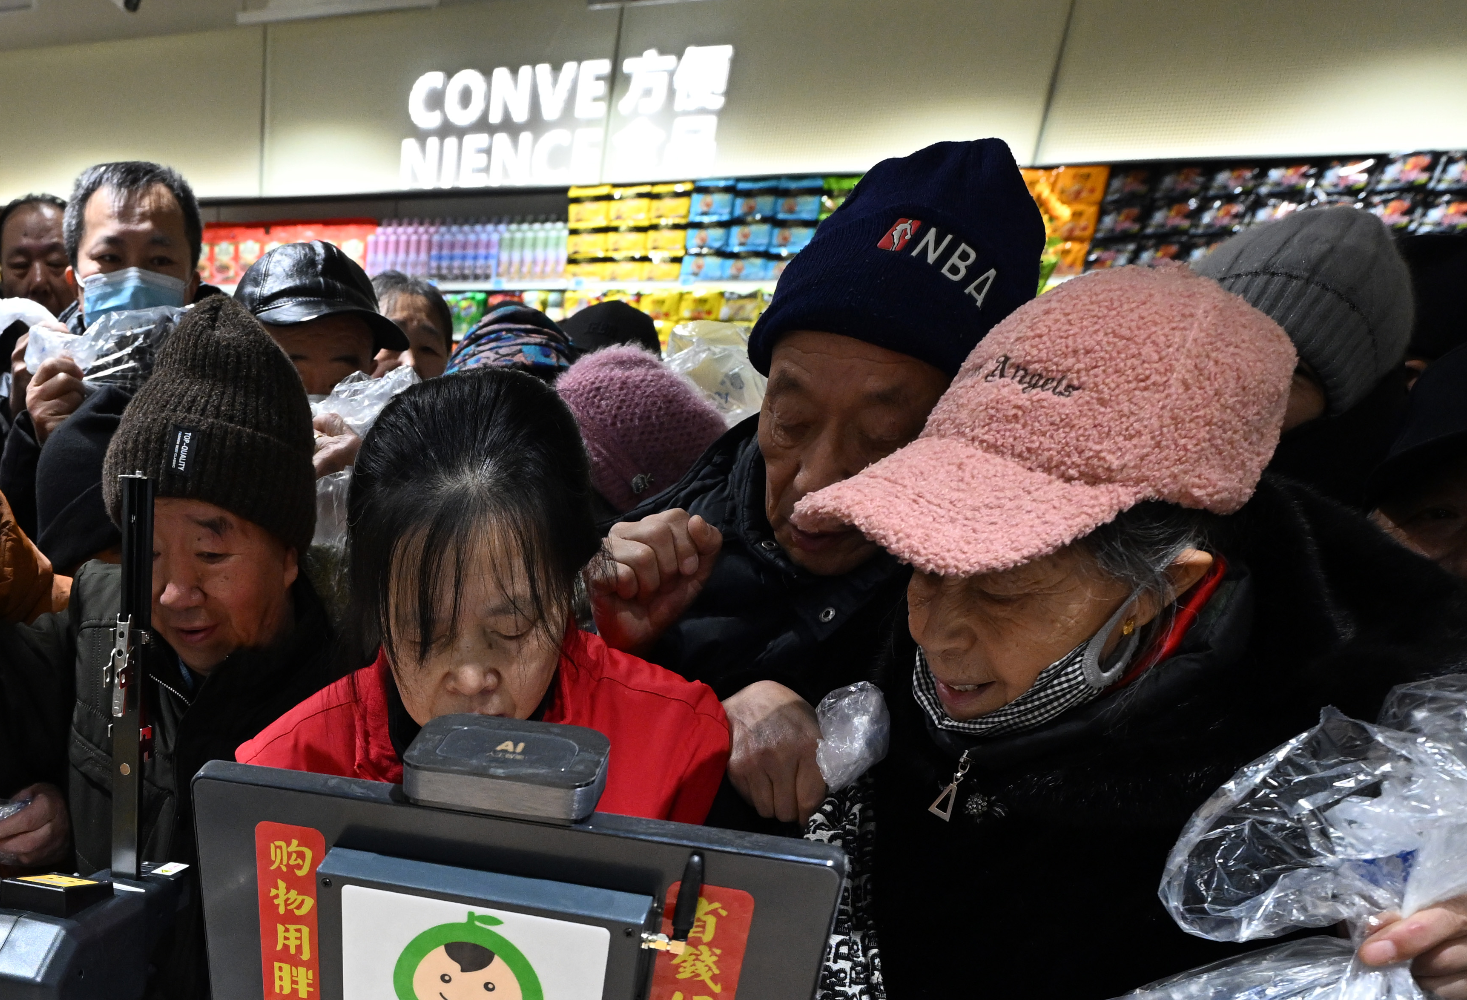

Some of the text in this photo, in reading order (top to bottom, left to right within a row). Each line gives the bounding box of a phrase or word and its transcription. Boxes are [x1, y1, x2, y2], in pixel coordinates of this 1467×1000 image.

[408, 58, 612, 129] CONVE
[399, 127, 605, 189] NIENCE
[910, 226, 997, 309] NBA
[984, 352, 1082, 398] Angels
[177, 432, 192, 472] TOP-QUALITY
[496, 740, 526, 753] AI
